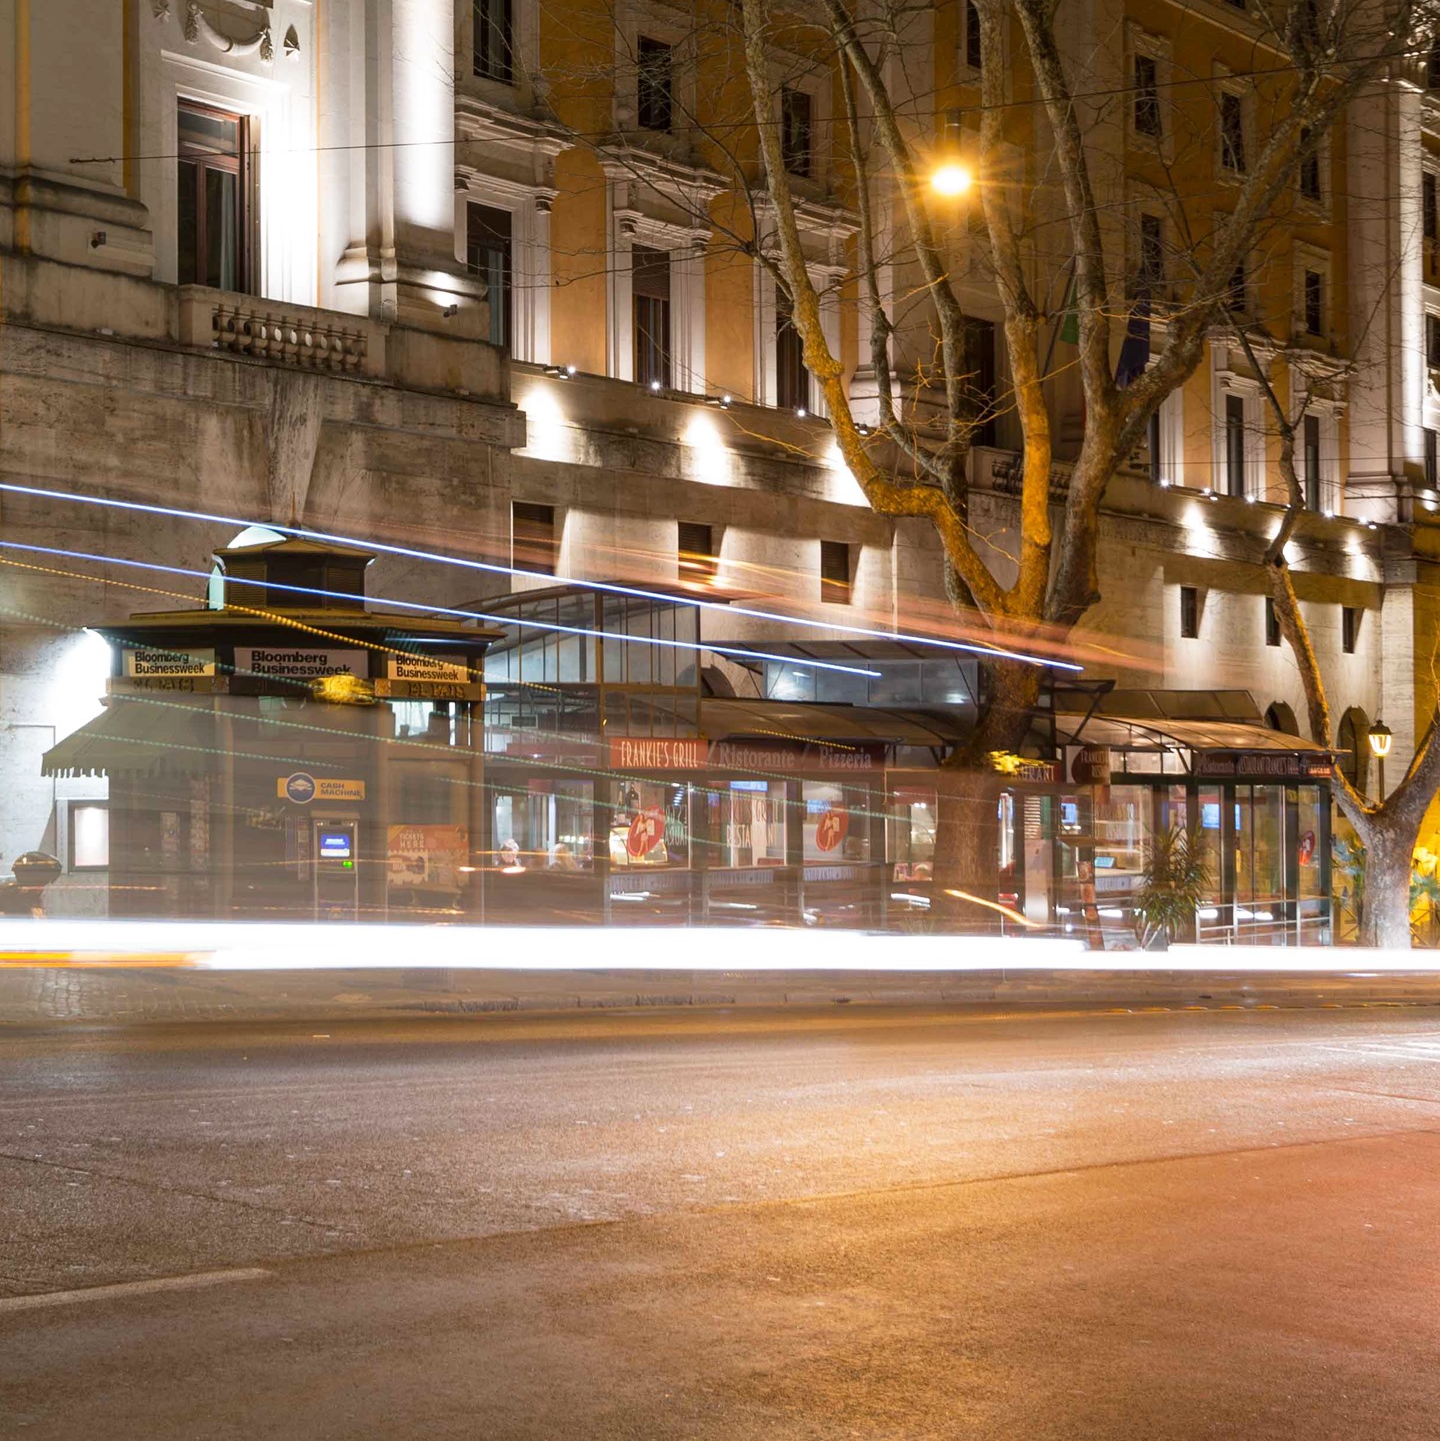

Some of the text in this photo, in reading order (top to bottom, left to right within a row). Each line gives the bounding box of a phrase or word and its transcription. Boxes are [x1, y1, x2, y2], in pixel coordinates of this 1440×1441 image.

[134, 651, 190, 665] Bloomberg
[251, 650, 328, 665] Bloomberg
[395, 654, 444, 670] Bloomberg
[134, 662, 206, 675] Businessweek
[251, 662, 352, 676] Businessweek
[396, 666, 460, 681] Businessweek
[620, 740, 698, 767] FRANKIE'S GRILL
[719, 742, 873, 770] Ristorante Pizzeria
[320, 789, 362, 797] MACHINE
